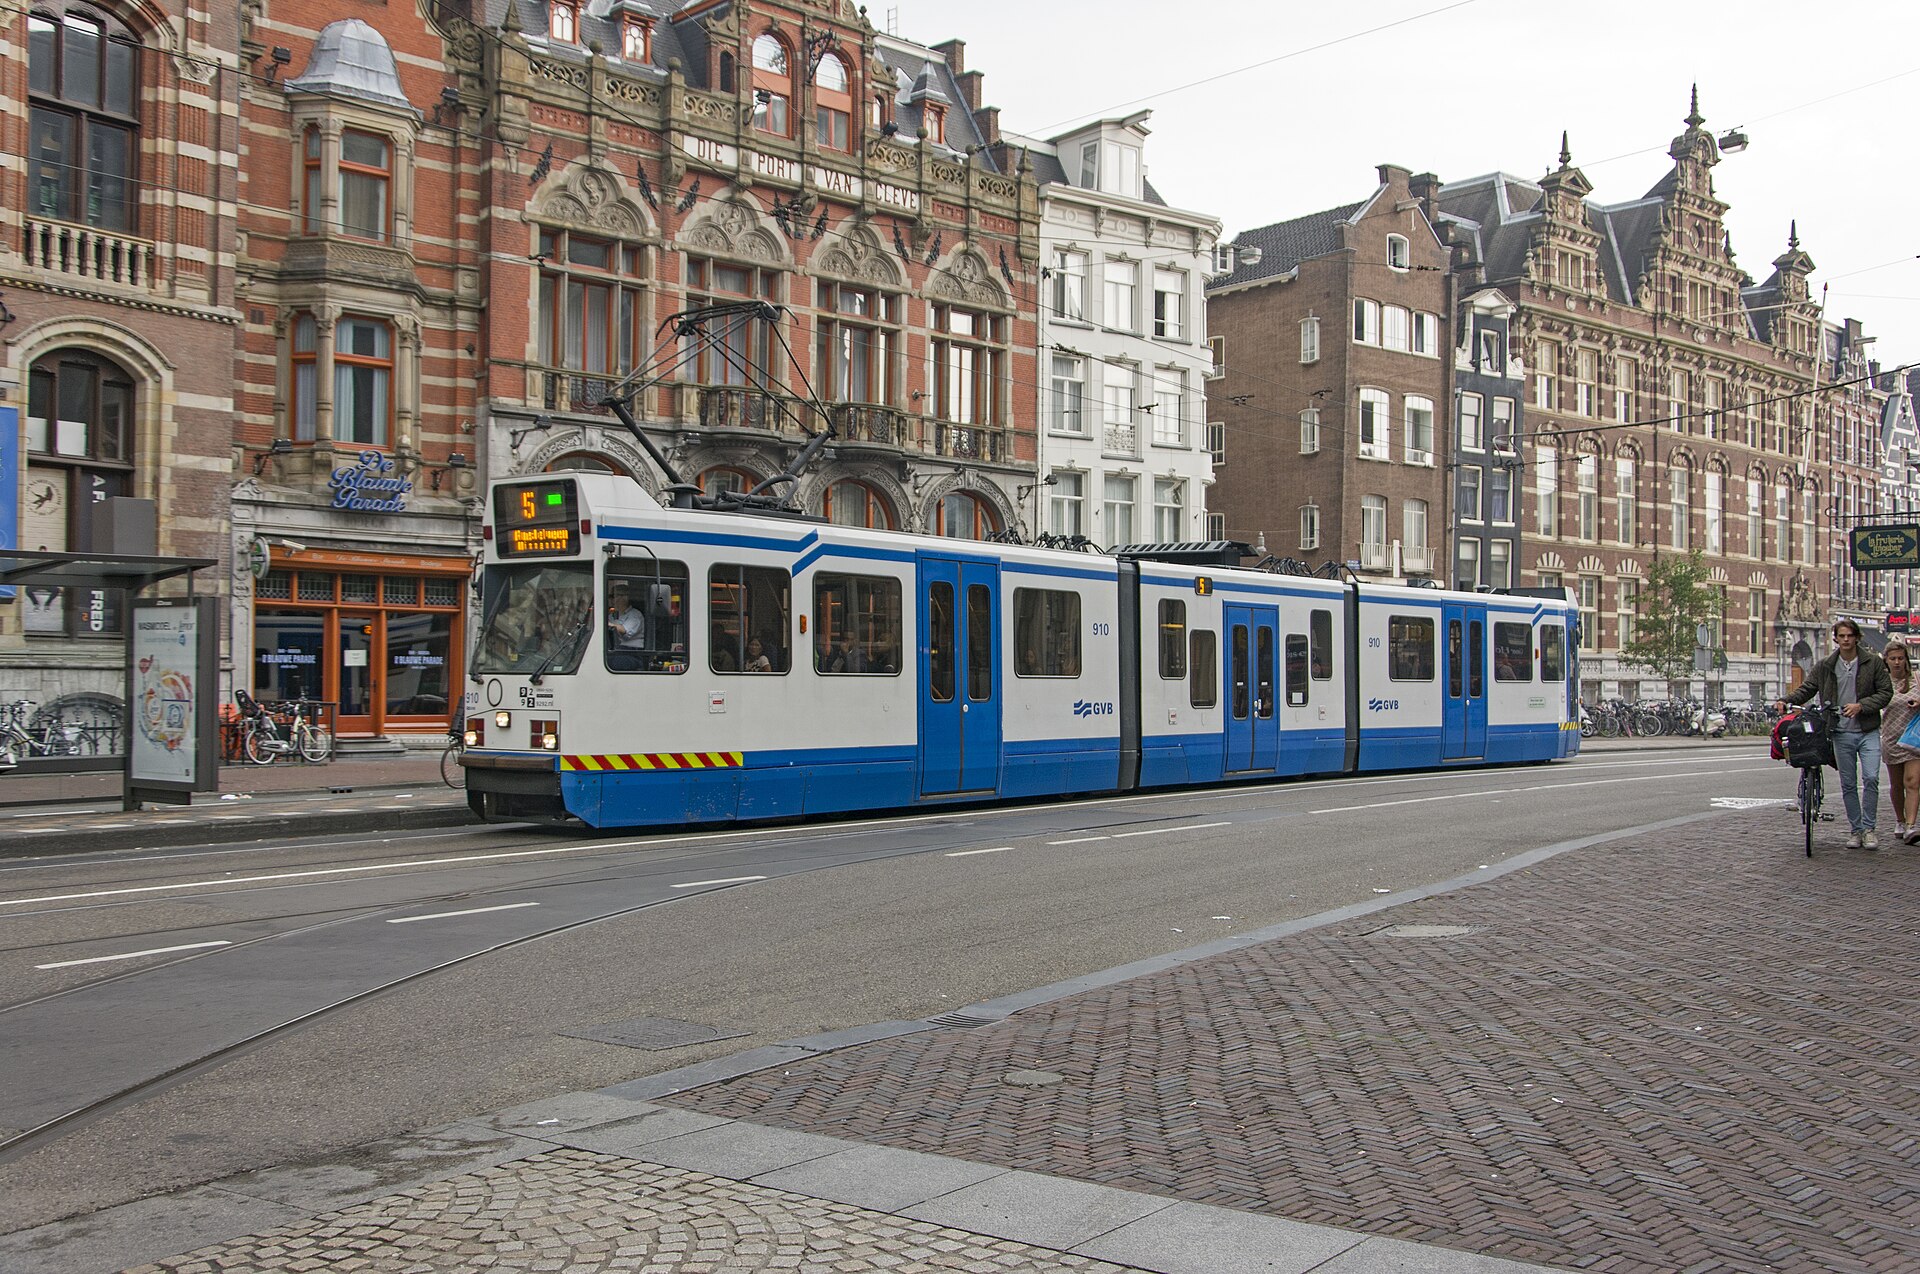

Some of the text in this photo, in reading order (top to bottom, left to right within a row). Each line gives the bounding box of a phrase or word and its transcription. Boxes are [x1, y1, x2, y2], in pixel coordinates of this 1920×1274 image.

[697, 138, 917, 210] DIE PORT VAN CLEVE
[356, 449, 395, 472] De
[327, 466, 413, 494] Blauwe
[331, 486, 407, 512] Parade
[522, 491, 535, 519] 5
[90, 590, 104, 631] FRED
[1092, 622, 1110, 636] 910
[1368, 637, 1381, 648] 910
[267, 655, 292, 663] BLAUWE
[293, 655, 316, 663] PARADE
[423, 656, 443, 664] PARADE
[466, 692, 480, 704] 910
[1383, 700, 1399, 710] GVB
[1093, 702, 1113, 715] GVB
